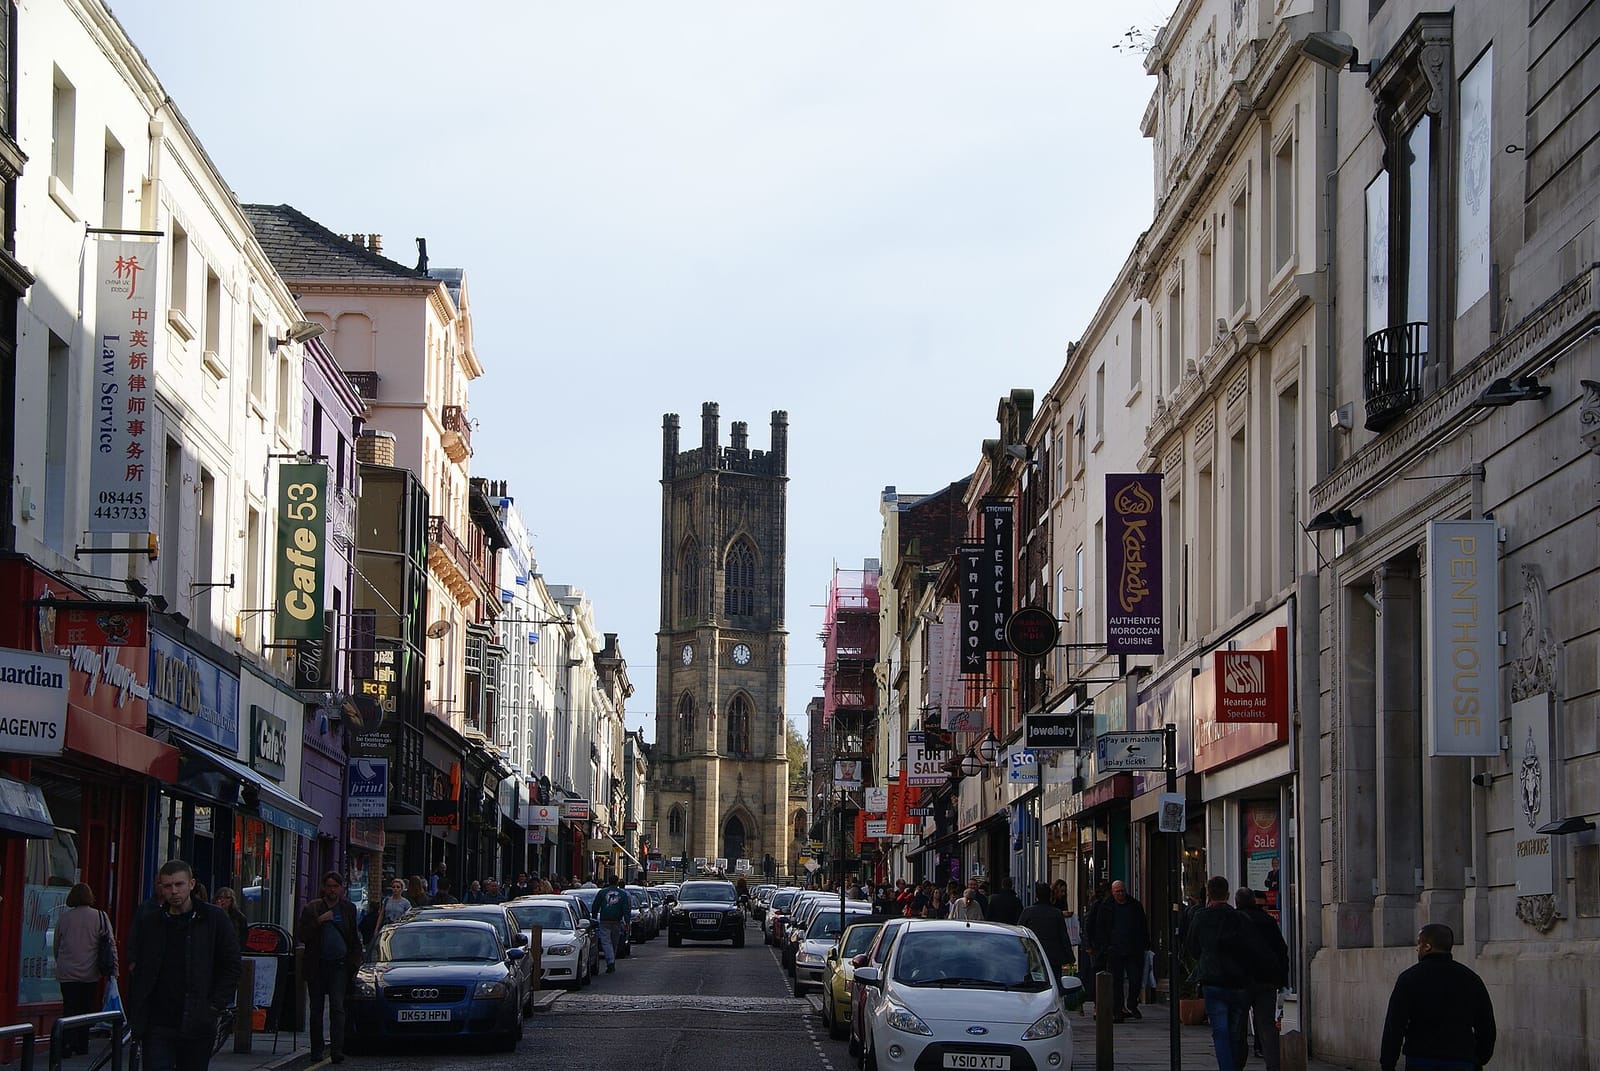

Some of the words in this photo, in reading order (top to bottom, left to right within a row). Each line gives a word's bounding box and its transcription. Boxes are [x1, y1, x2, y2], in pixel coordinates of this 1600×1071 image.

[100, 335, 120, 376] Law
[125, 307, 148, 482] 中英桥律师事务所
[98, 382, 119, 454] Service
[99, 491, 143, 505] 08445
[287, 482, 318, 521] 53
[94, 506, 147, 520] 443733
[285, 527, 317, 621] Cafe
[994, 518, 1004, 641] PIERCING
[968, 557, 979, 648] TATTOO
[1109, 616, 1161, 625] AUTHENTIC
[1110, 626, 1161, 635] MOROCCAN
[1450, 535, 1481, 737] PENTHOUSE
[1118, 637, 1153, 645] CUISINE
[1223, 698, 1253, 709] Hearing
[1254, 698, 1267, 707] Aid
[1227, 709, 1266, 718] Specialists
[0, 717, 57, 739] AGENTS
[1106, 736, 1119, 745] Pay
[917, 749, 941, 760] FOR
[1125, 757, 1146, 766] ticket
[914, 762, 945, 774] SALE
[350, 783, 384, 796] print
[909, 808, 930, 816] UTILITY
[1253, 834, 1275, 848] Sale
[1516, 836, 1550, 857] PENTHOUSE
[401, 1011, 427, 1021] DK53
[428, 1010, 447, 1020] HPN
[951, 1055, 977, 1067] YS10
[981, 1056, 1004, 1069] XTJ
